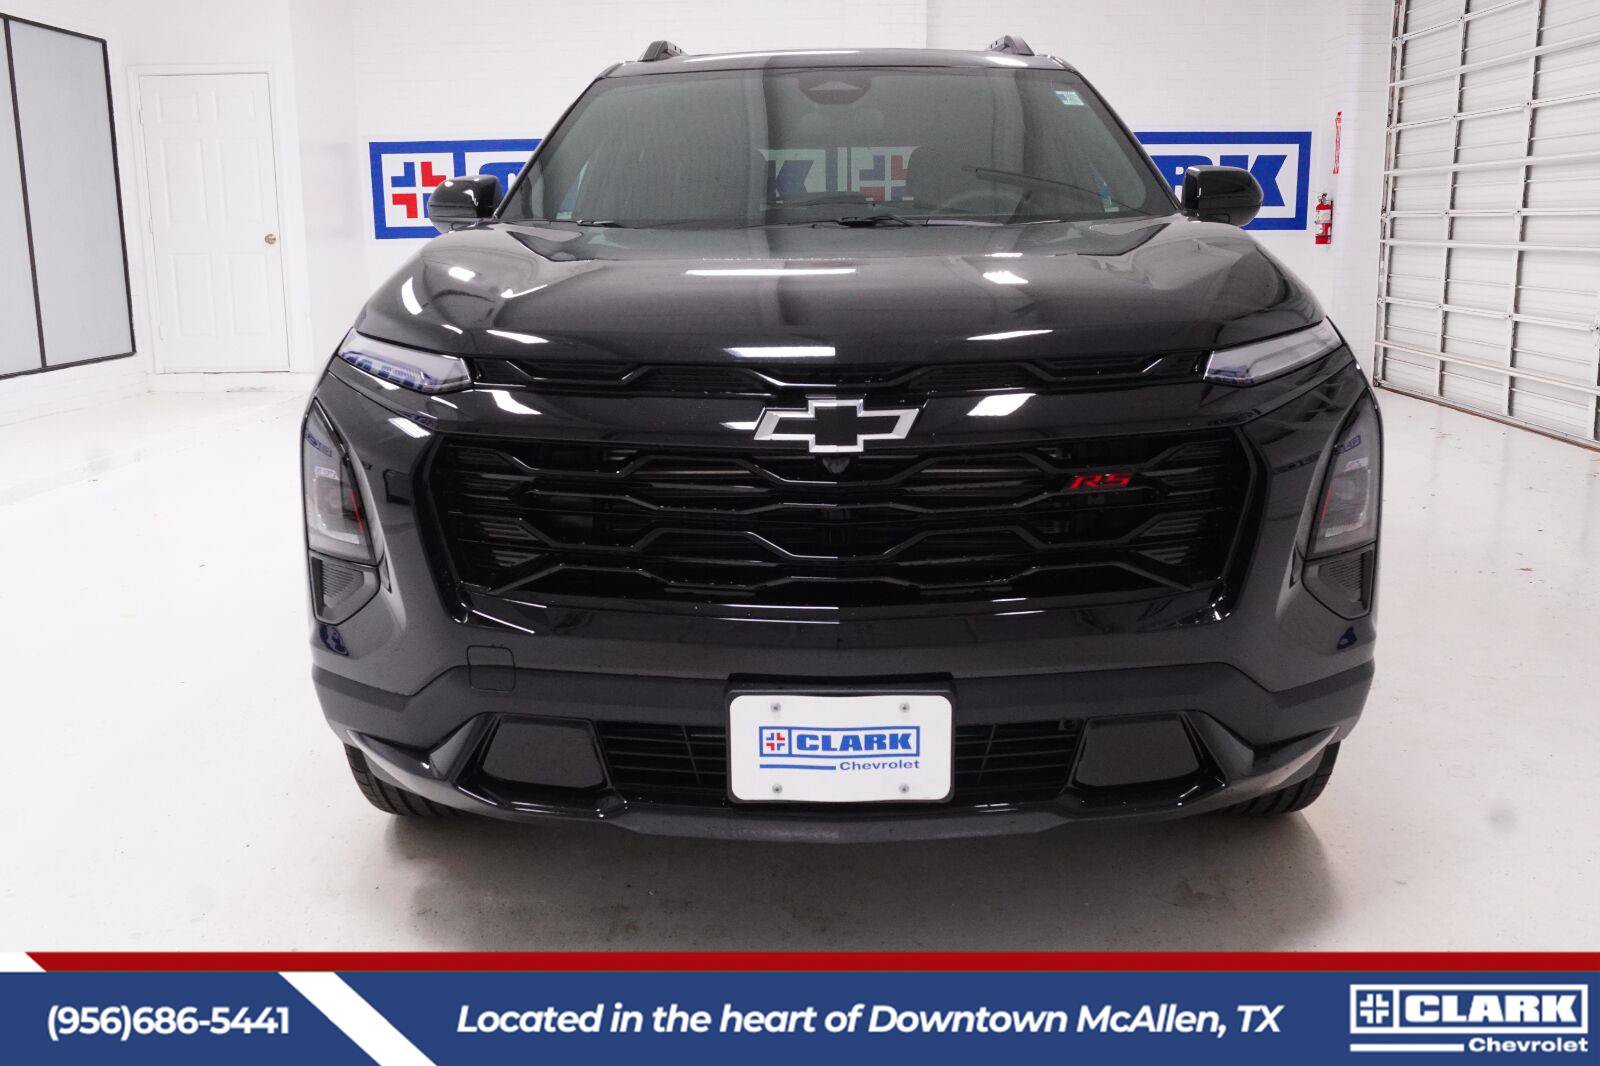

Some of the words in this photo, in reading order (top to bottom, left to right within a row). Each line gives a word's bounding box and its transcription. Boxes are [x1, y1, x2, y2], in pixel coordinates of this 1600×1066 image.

[1069, 471, 1132, 490] RS
[796, 733, 912, 751] CLARK
[839, 759, 920, 771] Chevrolet
